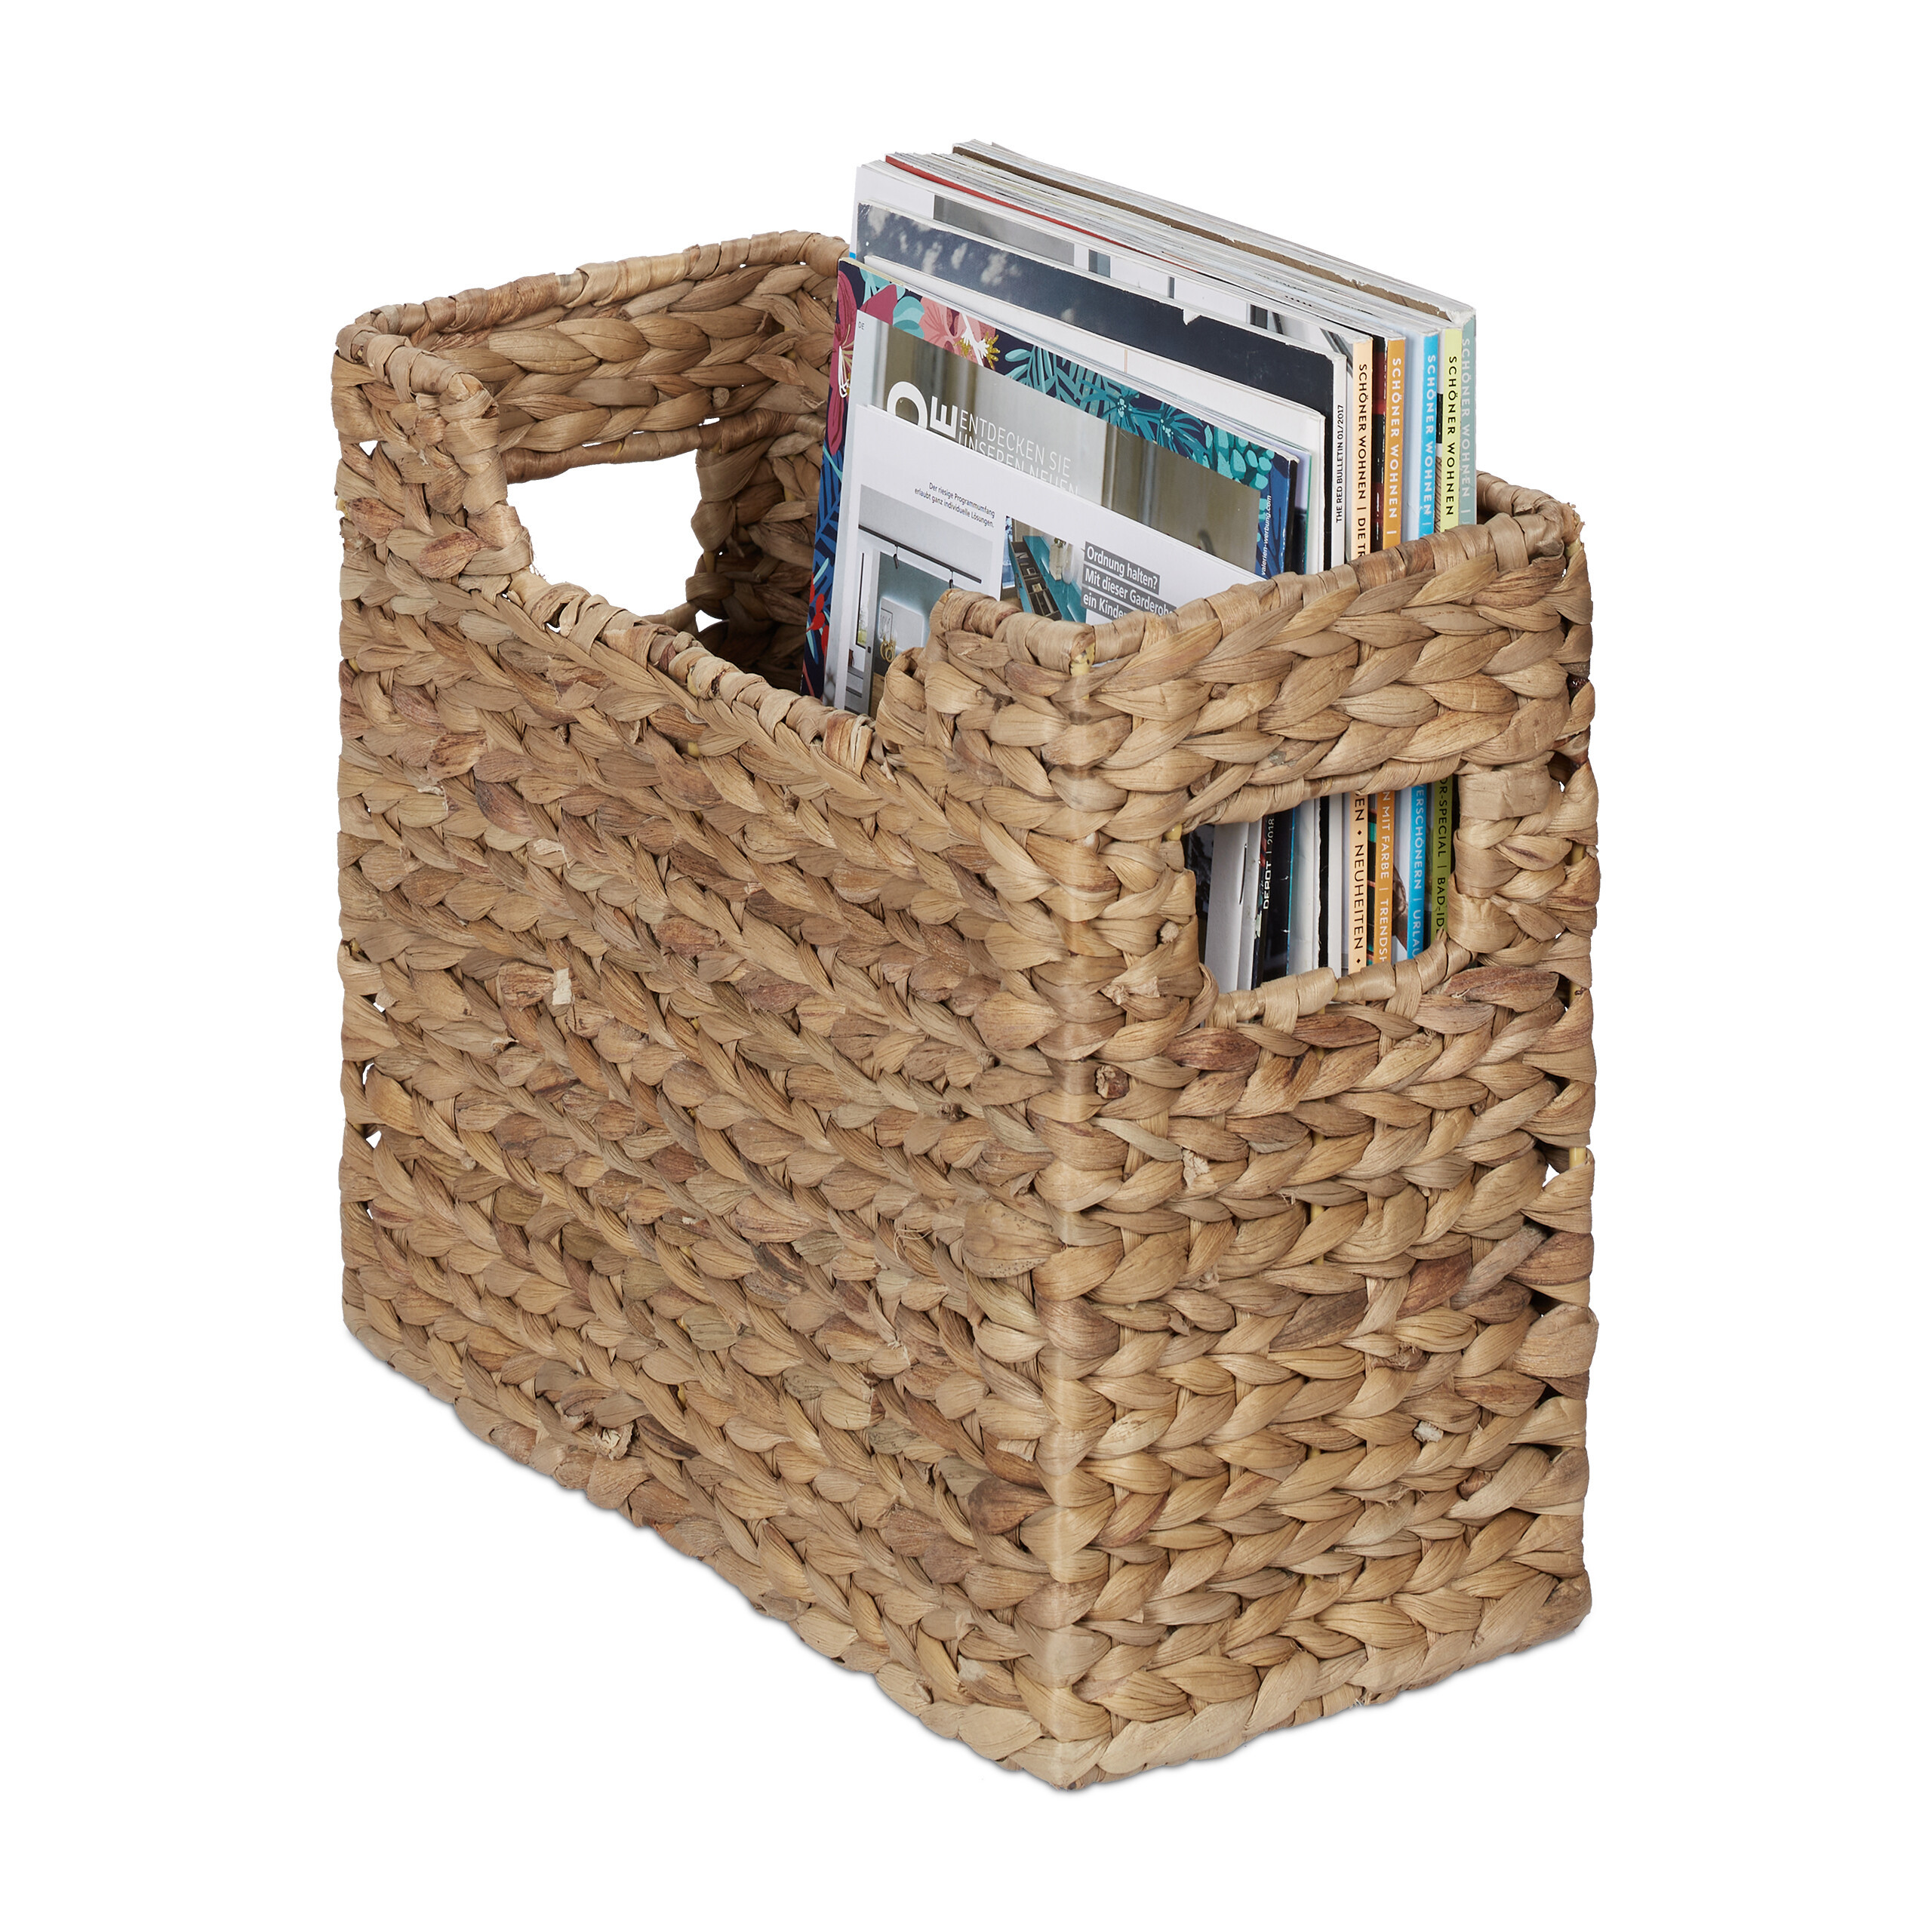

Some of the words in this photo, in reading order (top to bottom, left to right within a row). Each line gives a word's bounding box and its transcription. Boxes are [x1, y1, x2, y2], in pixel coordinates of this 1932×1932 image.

[1358, 364, 1368, 432] SCHÖNER
[1390, 358, 1401, 437] SCHÖNER
[1426, 355, 1436, 434] SCHÖNER
[1447, 356, 1458, 435] SCHÖNER
[1461, 338, 1472, 417] SCHÖNER
[960, 409, 1045, 466] ENTDECKEN
[1049, 451, 1072, 478] SIE
[1358, 435, 1367, 500] WOHNEN
[1461, 424, 1470, 497] WOHNEN
[914, 488, 931, 500] erlaubt
[931, 495, 943, 505] ganz
[943, 499, 971, 518] individuelle
[929, 482, 938, 491] Der
[938, 486, 954, 500] riesige
[954, 493, 995, 519] Programmumfang
[1389, 445, 1399, 518] WOHNEN
[1423, 441, 1433, 515] WOHNEN
[1446, 442, 1456, 515] WOHNEN
[1261, 495, 1272, 576] valerien-werbung.com
[1357, 518, 1366, 540] DIE
[1083, 592, 1097, 608] ein
[1084, 568, 1101, 587] Mit
[1102, 576, 1128, 599] dieser
[1129, 589, 1173, 617] Garderob
[1087, 546, 1125, 578] Ordnung
[1127, 562, 1158, 590] halten?
[1266, 818, 1275, 845] 2018
[1382, 806, 1391, 831] MIT
[1263, 860, 1272, 909] DEPOT
[1380, 835, 1390, 880] FARBE
[1354, 844, 1364, 950] NEUHEITEN
[1435, 877, 1446, 934] BAD-ID
